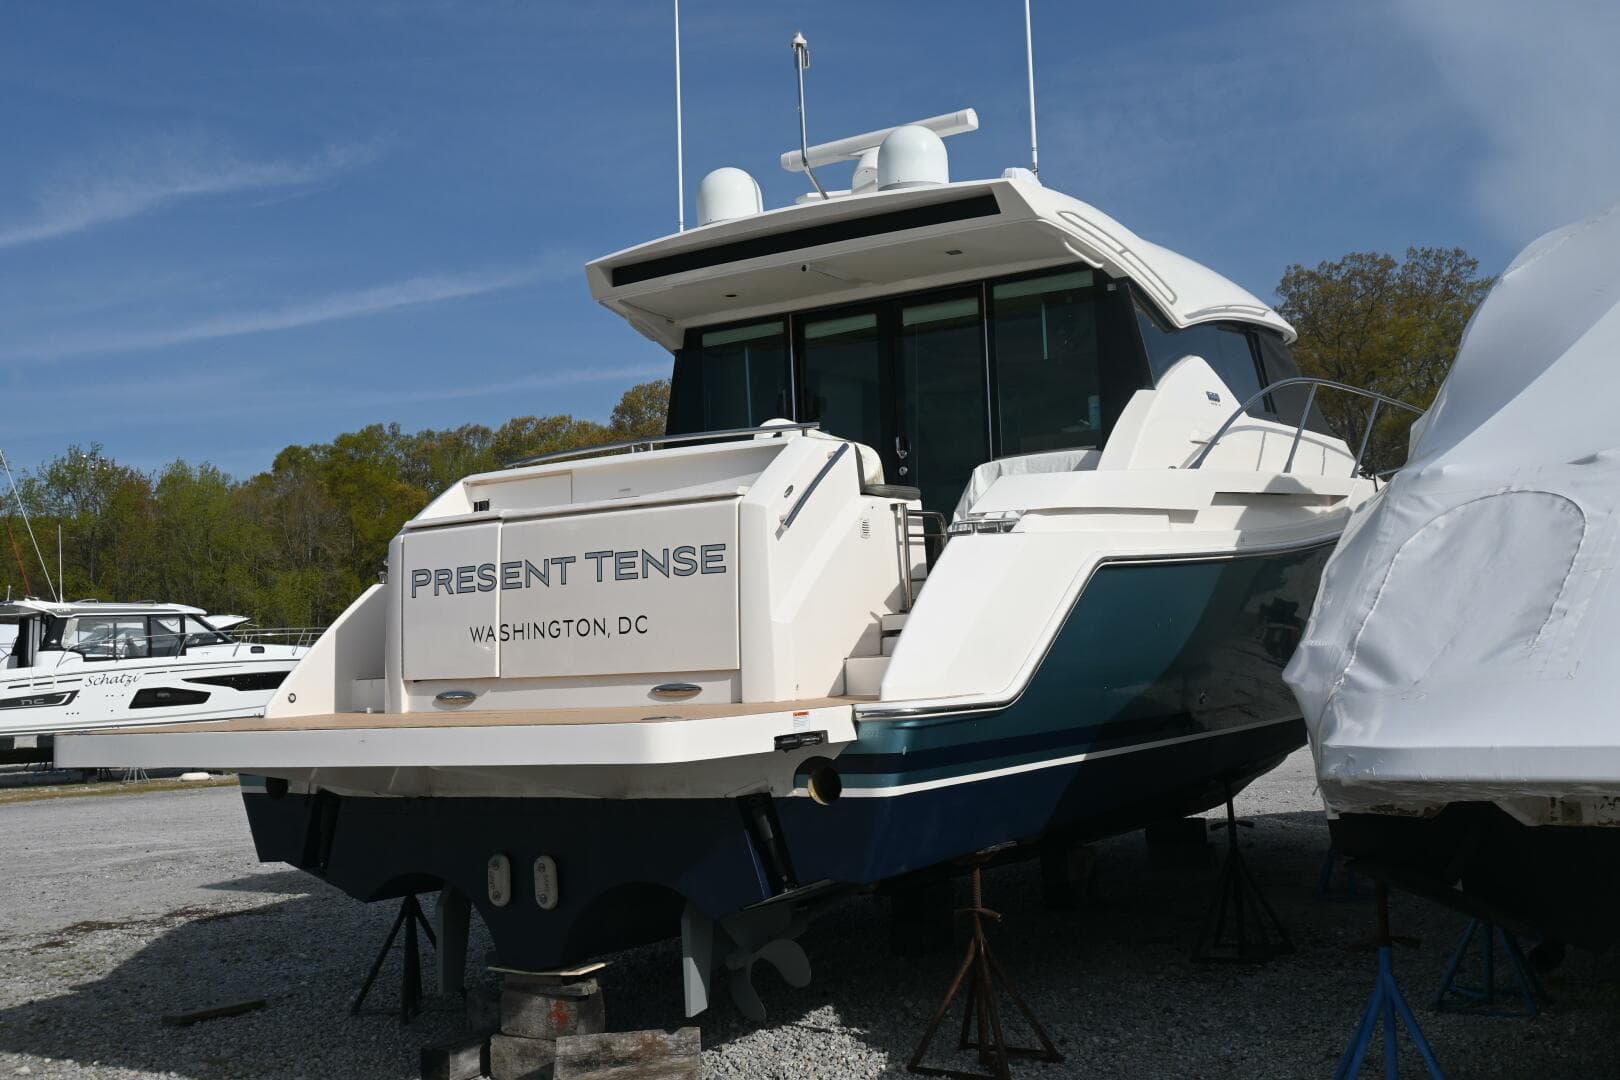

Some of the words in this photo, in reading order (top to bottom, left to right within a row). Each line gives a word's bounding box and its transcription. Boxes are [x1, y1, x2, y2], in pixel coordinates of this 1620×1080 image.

[411, 555, 577, 598] PRESENT
[584, 543, 727, 583] TENSE
[469, 617, 611, 642] WASHINGTON,
[618, 615, 648, 635] DC
[85, 673, 140, 687] Schatzi
